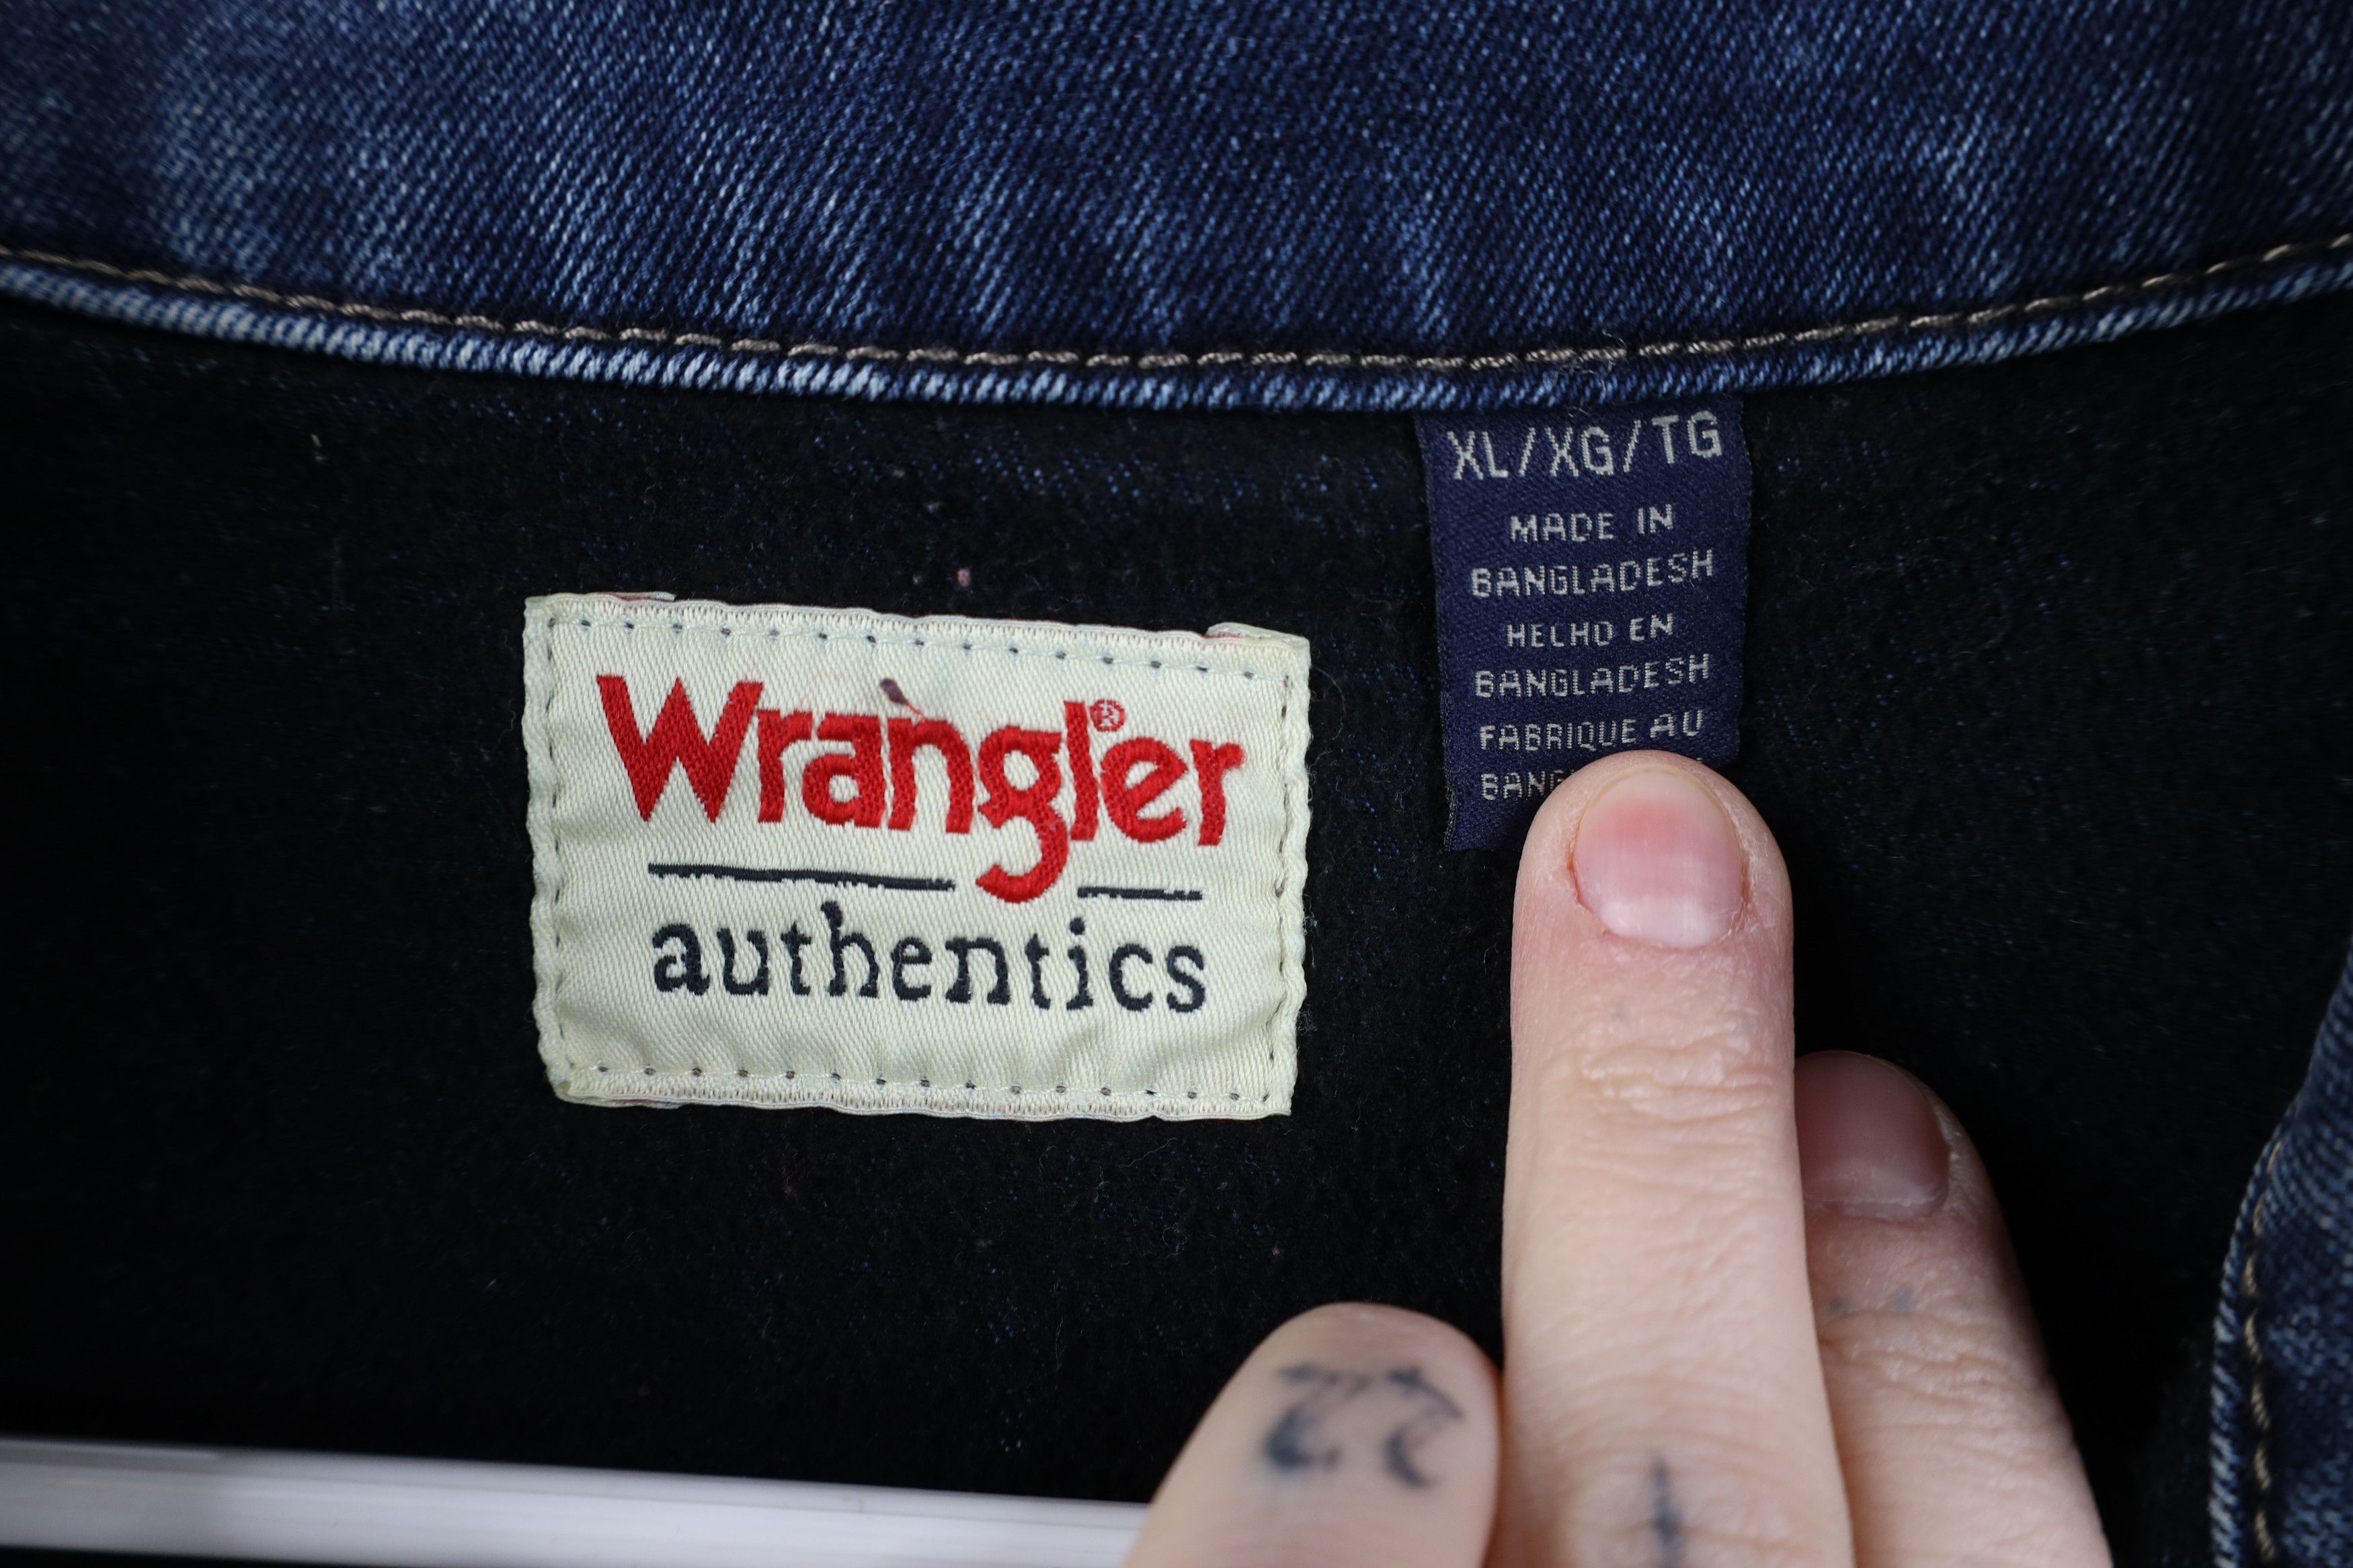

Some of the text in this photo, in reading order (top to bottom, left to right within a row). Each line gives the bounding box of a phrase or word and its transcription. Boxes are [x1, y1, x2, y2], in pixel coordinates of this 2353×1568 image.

[1446, 411, 1723, 480] XL/XG/TG
[1510, 503, 1674, 542] MADE IN
[1471, 548, 1713, 597] BANGLADESH
[1507, 613, 1674, 647] HECHO EN
[1476, 653, 1710, 697] BANGLADESH
[1480, 710, 1704, 751] FABRIQUE AU
[652, 901, 1207, 1013] authentics
